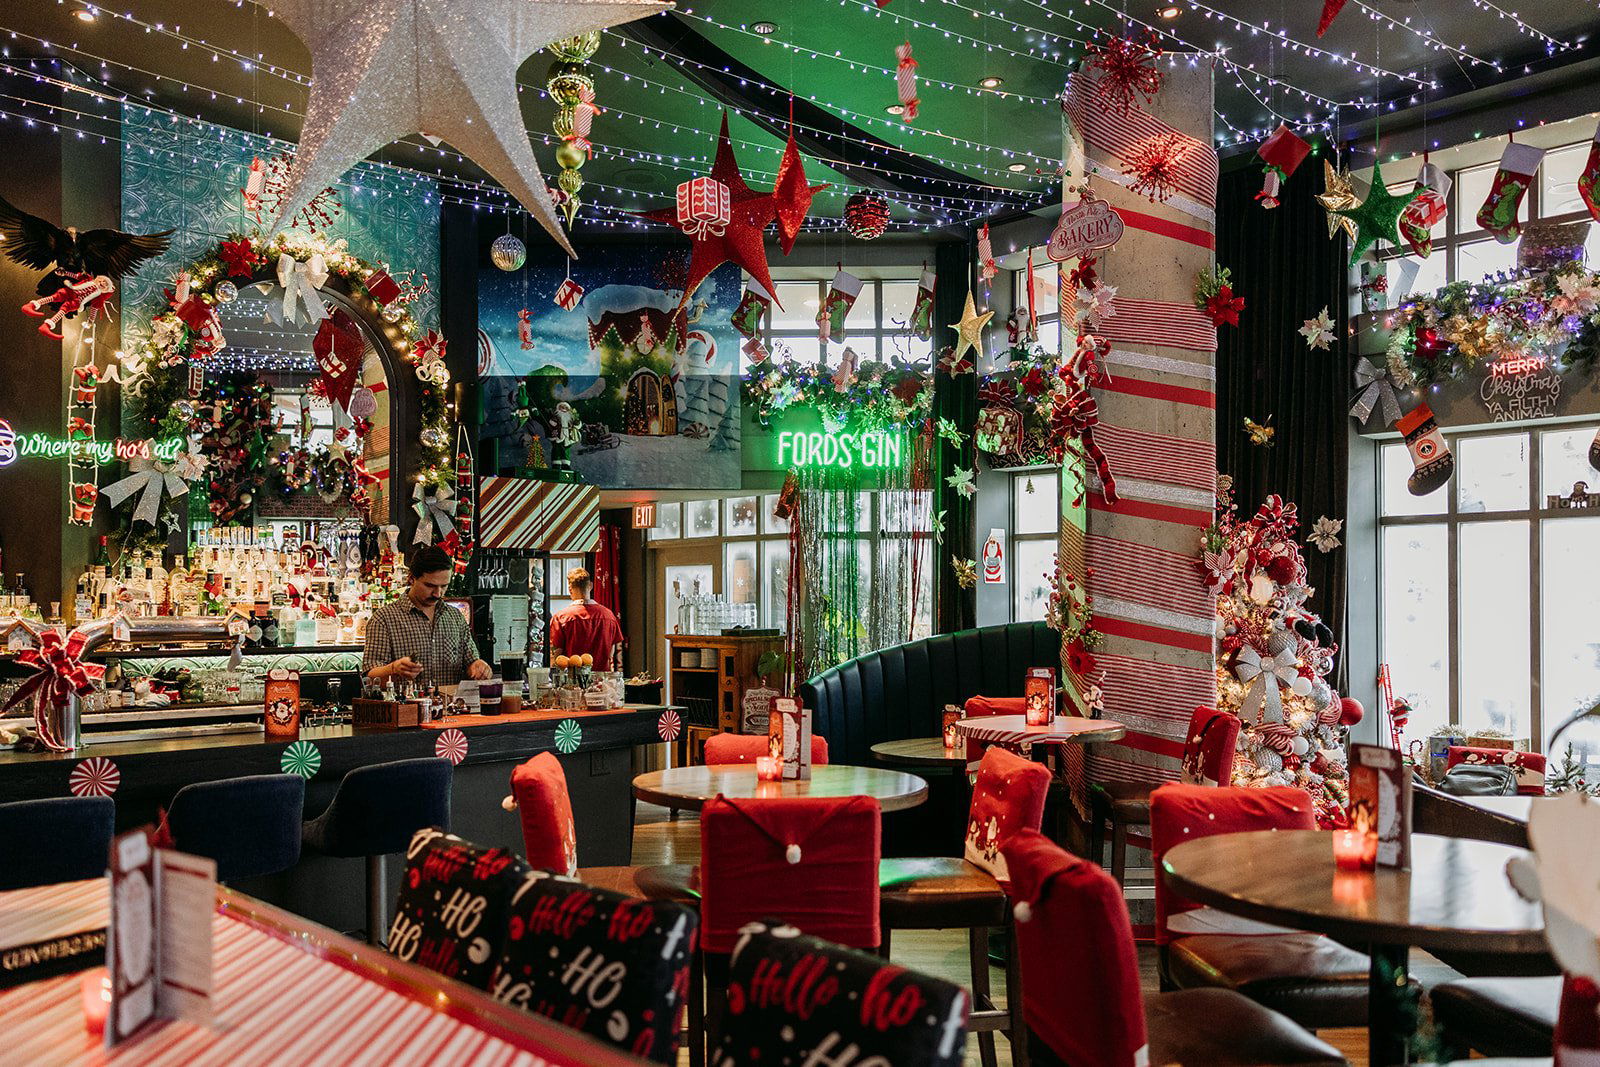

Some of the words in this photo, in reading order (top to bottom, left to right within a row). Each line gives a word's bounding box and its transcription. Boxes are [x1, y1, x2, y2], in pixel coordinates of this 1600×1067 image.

[1058, 215, 1114, 249] BAKERY
[1492, 357, 1546, 376] MERRY
[1480, 374, 1562, 401] Christmas
[1485, 401, 1504, 414] YA
[1508, 393, 1560, 412] FILTHY
[1494, 406, 1554, 423] ANIMAL
[16, 433, 82, 456] Where
[86, 441, 114, 463] my
[116, 437, 150, 460] ho's
[153, 437, 183, 460] at?
[777, 431, 854, 468] FORDS
[860, 432, 900, 468] GIN
[635, 505, 653, 527] EXIT
[440, 887, 488, 939] HO
[388, 911, 423, 963] HO
[560, 946, 628, 1010] HO
[750, 953, 840, 1021] Hello
[860, 964, 925, 1033] ho
